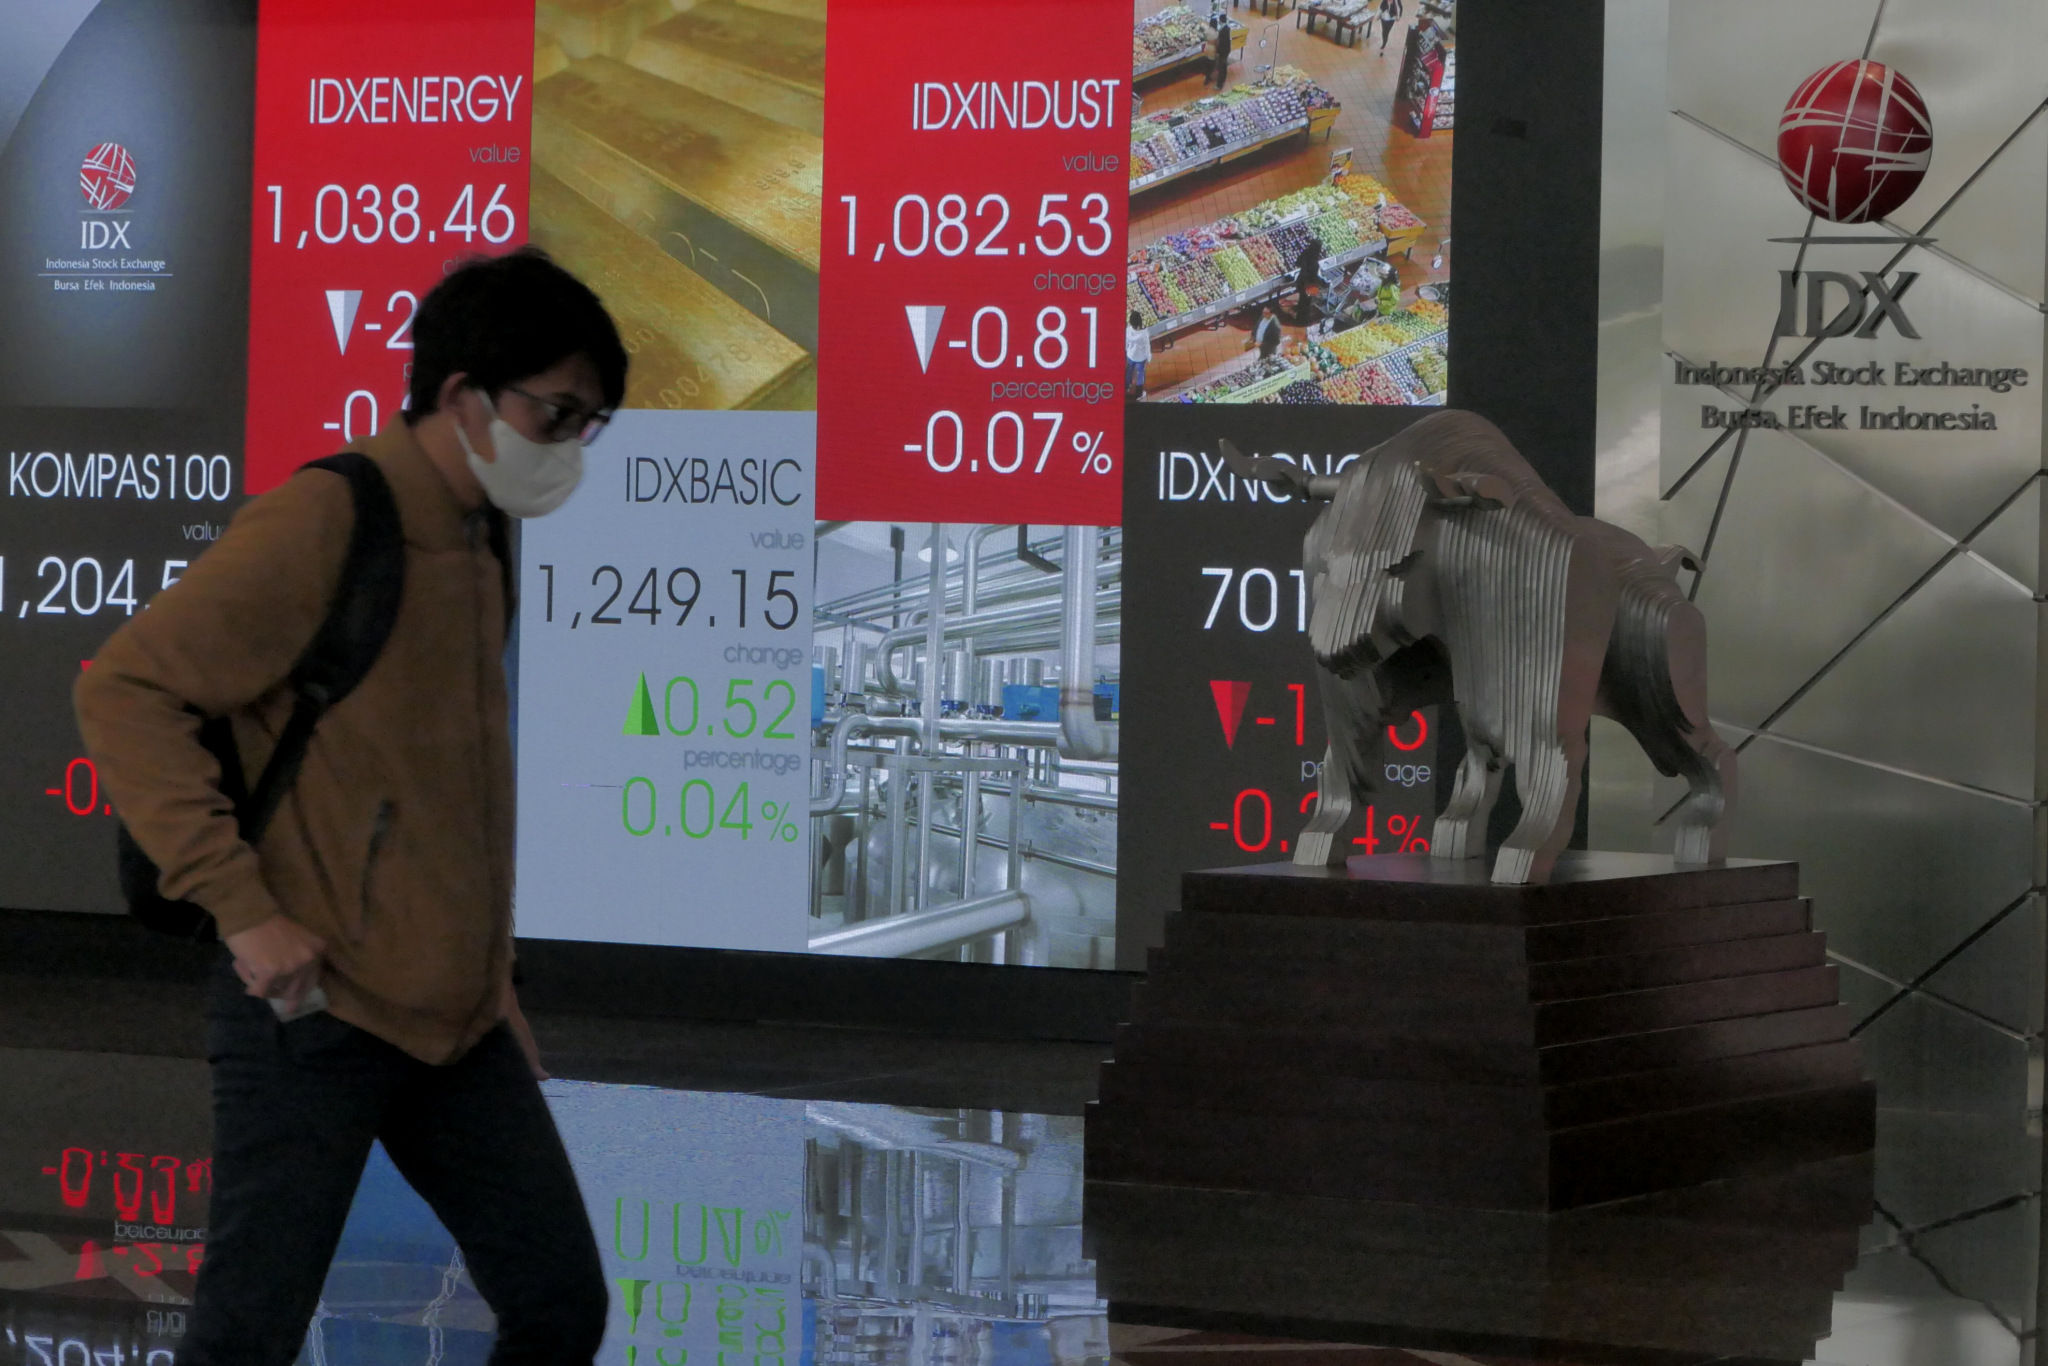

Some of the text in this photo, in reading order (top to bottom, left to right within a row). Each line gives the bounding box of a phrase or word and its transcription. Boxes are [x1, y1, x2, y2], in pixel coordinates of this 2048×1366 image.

[309, 75, 523, 124] IDXENERGY
[912, 79, 1121, 131] IDXINDUST
[469, 145, 521, 163] value
[1062, 152, 1120, 172] value
[267, 184, 515, 249] 1,038.46
[841, 194, 1112, 262] 1,082.53
[81, 221, 131, 249] IDX
[46, 258, 166, 272] Indonesia Stock Exchange
[54, 280, 156, 291] Bursa Efek Indonesia
[1033, 270, 1117, 296] change
[1778, 270, 1922, 339] IDX
[949, 306, 1099, 369] -0.81
[991, 380, 1113, 402] percentage
[1674, 361, 2028, 393] Indonesia Stock Exchange
[1701, 404, 1998, 430] Bursa Efek Indonesia
[9, 452, 231, 500] KOMPAS100
[626, 457, 802, 505] IDXBASIC
[182, 521, 225, 541] valu
[750, 530, 805, 550] value
[539, 564, 799, 630] 1,249.15
[724, 645, 804, 671] change
[664, 676, 796, 740] 0.52
[684, 748, 800, 775] percentage
